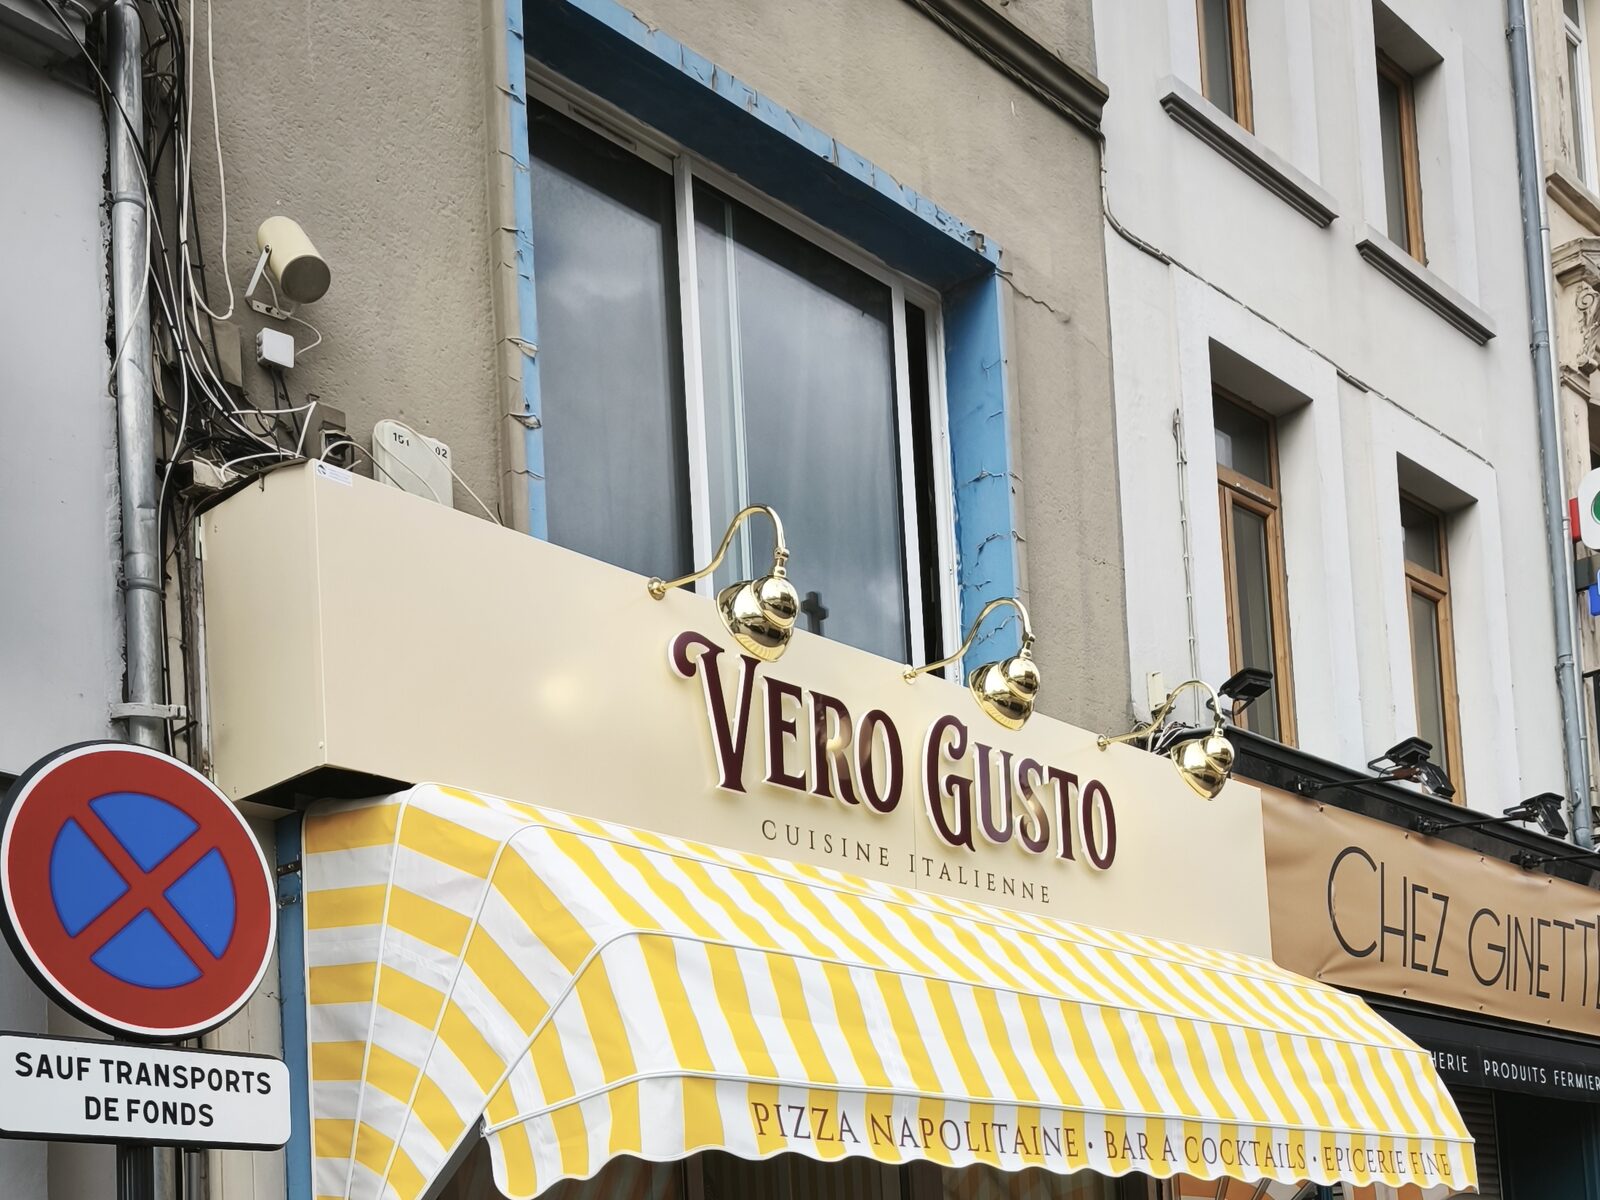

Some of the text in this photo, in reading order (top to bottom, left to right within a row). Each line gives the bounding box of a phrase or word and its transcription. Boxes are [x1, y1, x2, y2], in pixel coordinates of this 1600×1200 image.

[668, 630, 1117, 871] VERO GUSTO
[761, 819, 1051, 904] CUISINE ITALIENNE
[1327, 845, 1600, 1010] CHEZ GINETT
[15, 1051, 272, 1095] SAUF TRANSPORTS
[1483, 1059, 1547, 1084] PRODUITS
[84, 1096, 214, 1127] DE FONDS
[751, 1101, 1451, 1177] PIZZA NAPOLITAINE BAR A COCKTAILS EPICERIE FINE
